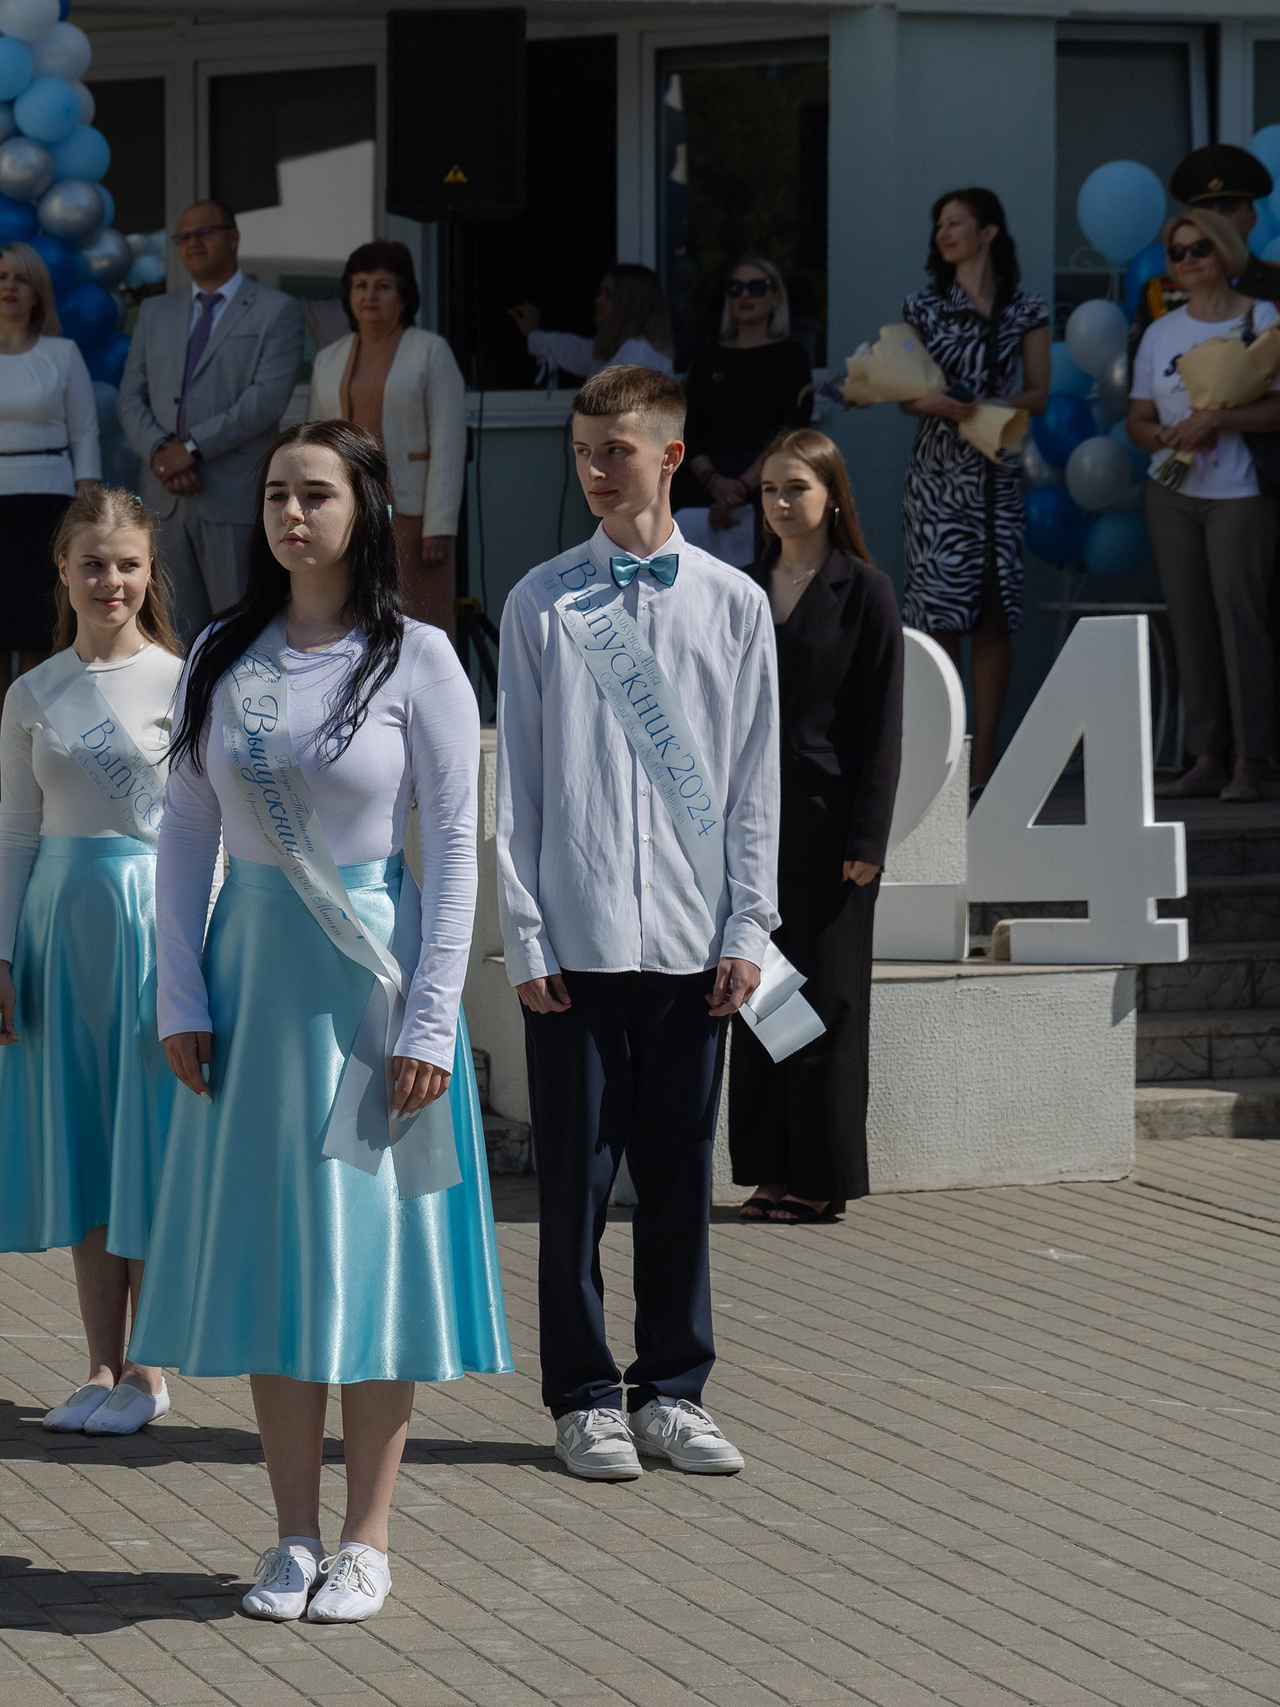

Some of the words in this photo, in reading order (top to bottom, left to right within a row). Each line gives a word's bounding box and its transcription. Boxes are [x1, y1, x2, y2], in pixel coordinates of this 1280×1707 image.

[562, 610, 583, 639] класс
[600, 672, 628, 719] Средняя
[626, 719, 644, 749] школа
[611, 606, 645, 658] Жикунов
[641, 655, 661, 687] Илья
[289, 793, 314, 853] Татьяна
